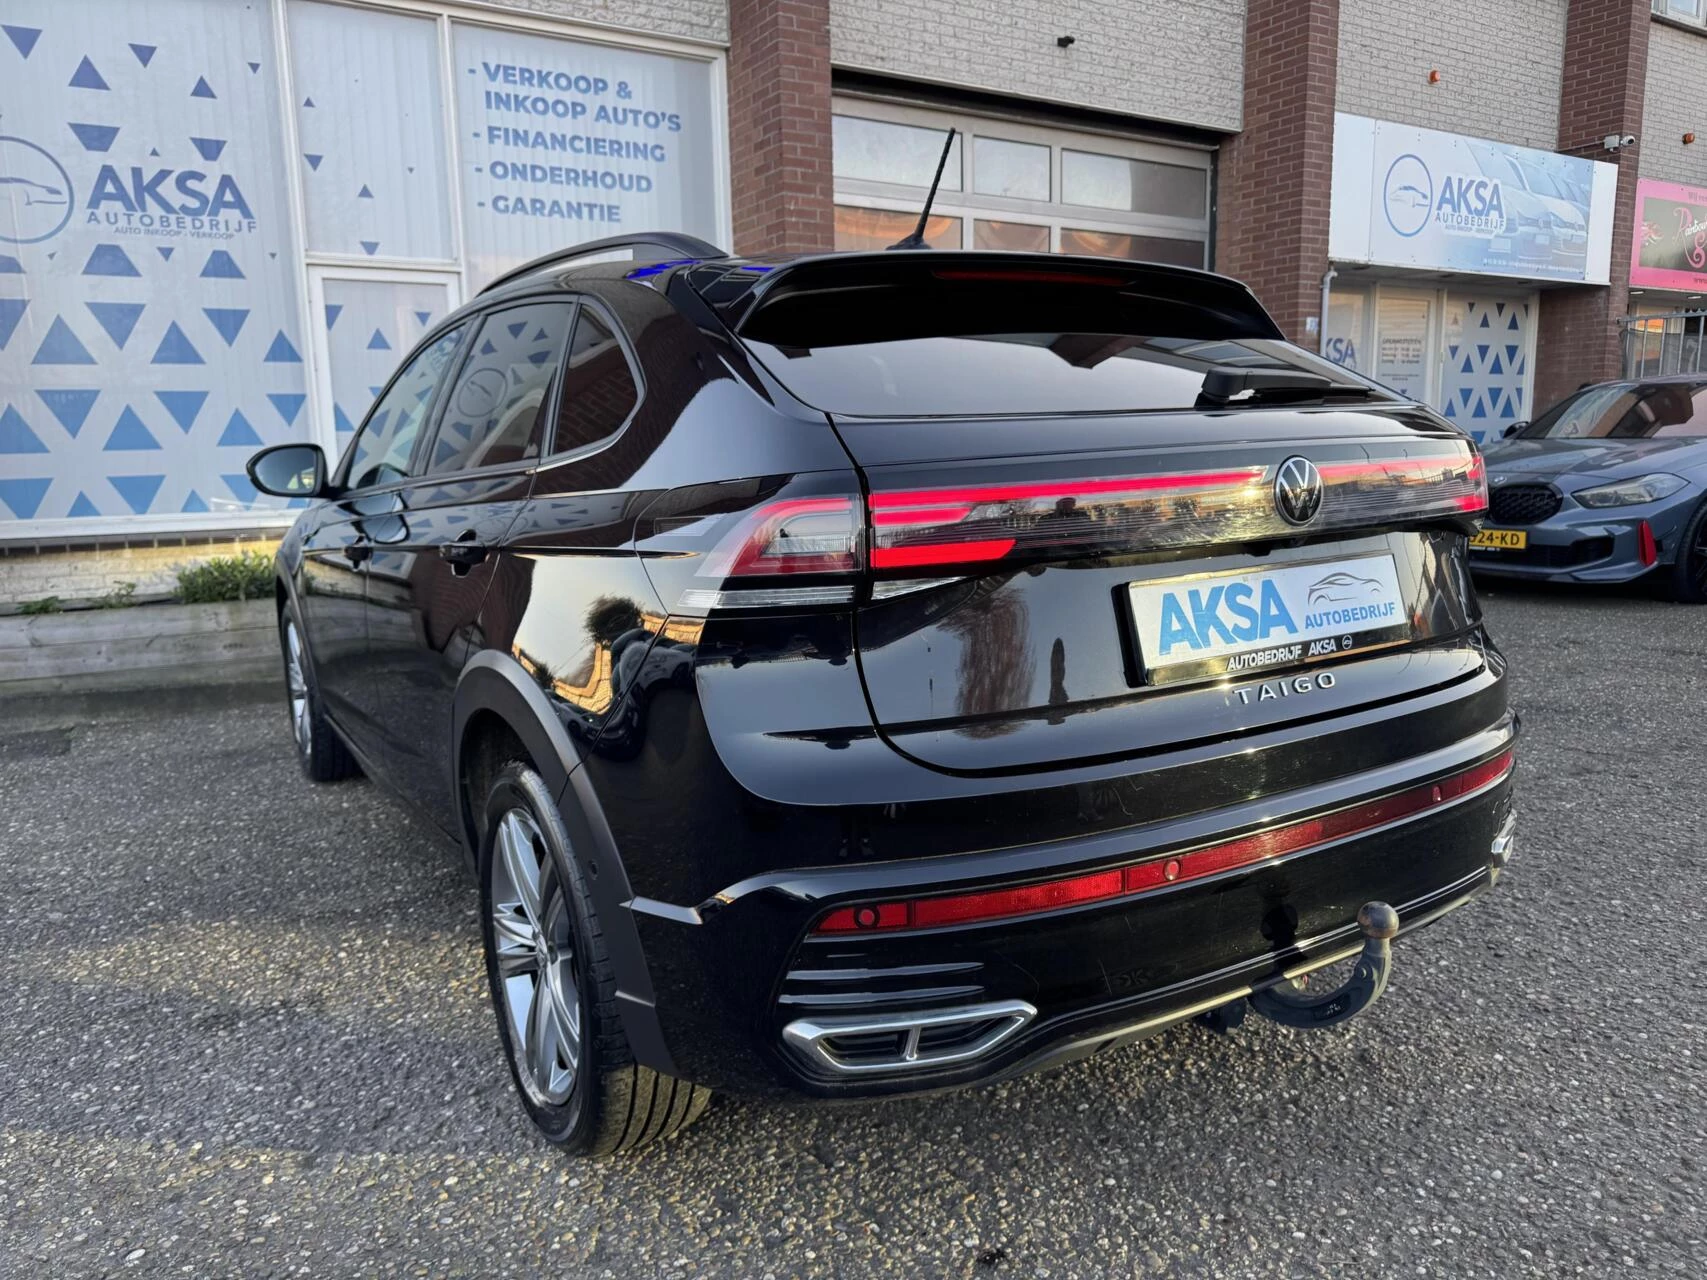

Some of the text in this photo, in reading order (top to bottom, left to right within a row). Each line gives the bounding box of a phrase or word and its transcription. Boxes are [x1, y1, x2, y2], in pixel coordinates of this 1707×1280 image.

[482, 62, 609, 95] VERKOOP
[616, 81, 633, 99] &
[485, 91, 682, 132] INKOOP AUTO'S
[487, 126, 666, 163] FINANCIERING
[86, 164, 255, 220] AKSA
[489, 161, 653, 193] ONDERHOUD
[492, 195, 622, 223] GARANTIE
[1436, 176, 1504, 218] AKSA
[87, 211, 256, 234] AUTOBEDRIJF
[114, 227, 141, 236] AUTO
[1435, 212, 1505, 230] AUTOBEDRIJF
[1159, 579, 1298, 656] AKSA
[1304, 602, 1396, 629] AUTOBEDRIJF
[1226, 638, 1337, 672] AUTOBEDRIJF AKSA
[1233, 672, 1336, 705] TAIGO
